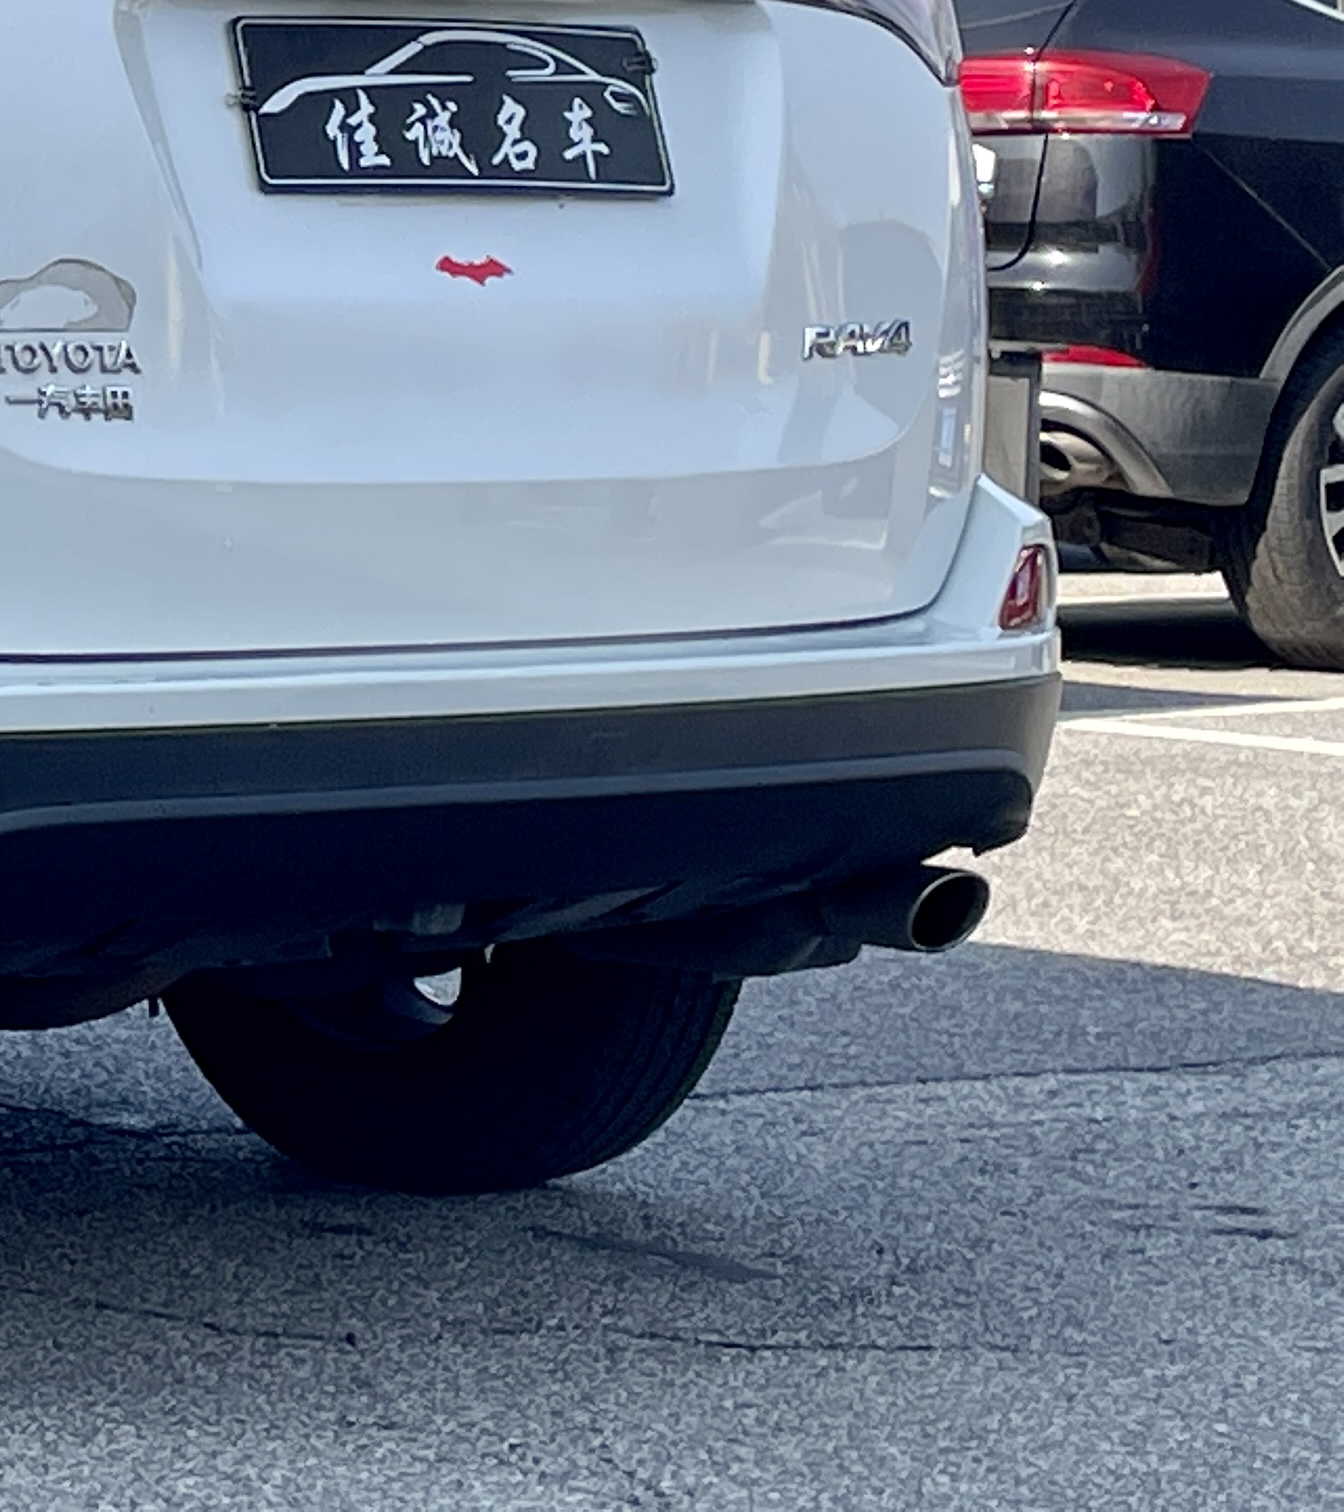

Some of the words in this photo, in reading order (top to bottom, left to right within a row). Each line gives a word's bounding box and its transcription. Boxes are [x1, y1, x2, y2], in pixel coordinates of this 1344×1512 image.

[324, 88, 611, 180] 佳诚名车
[801, 317, 913, 362] RAV4
